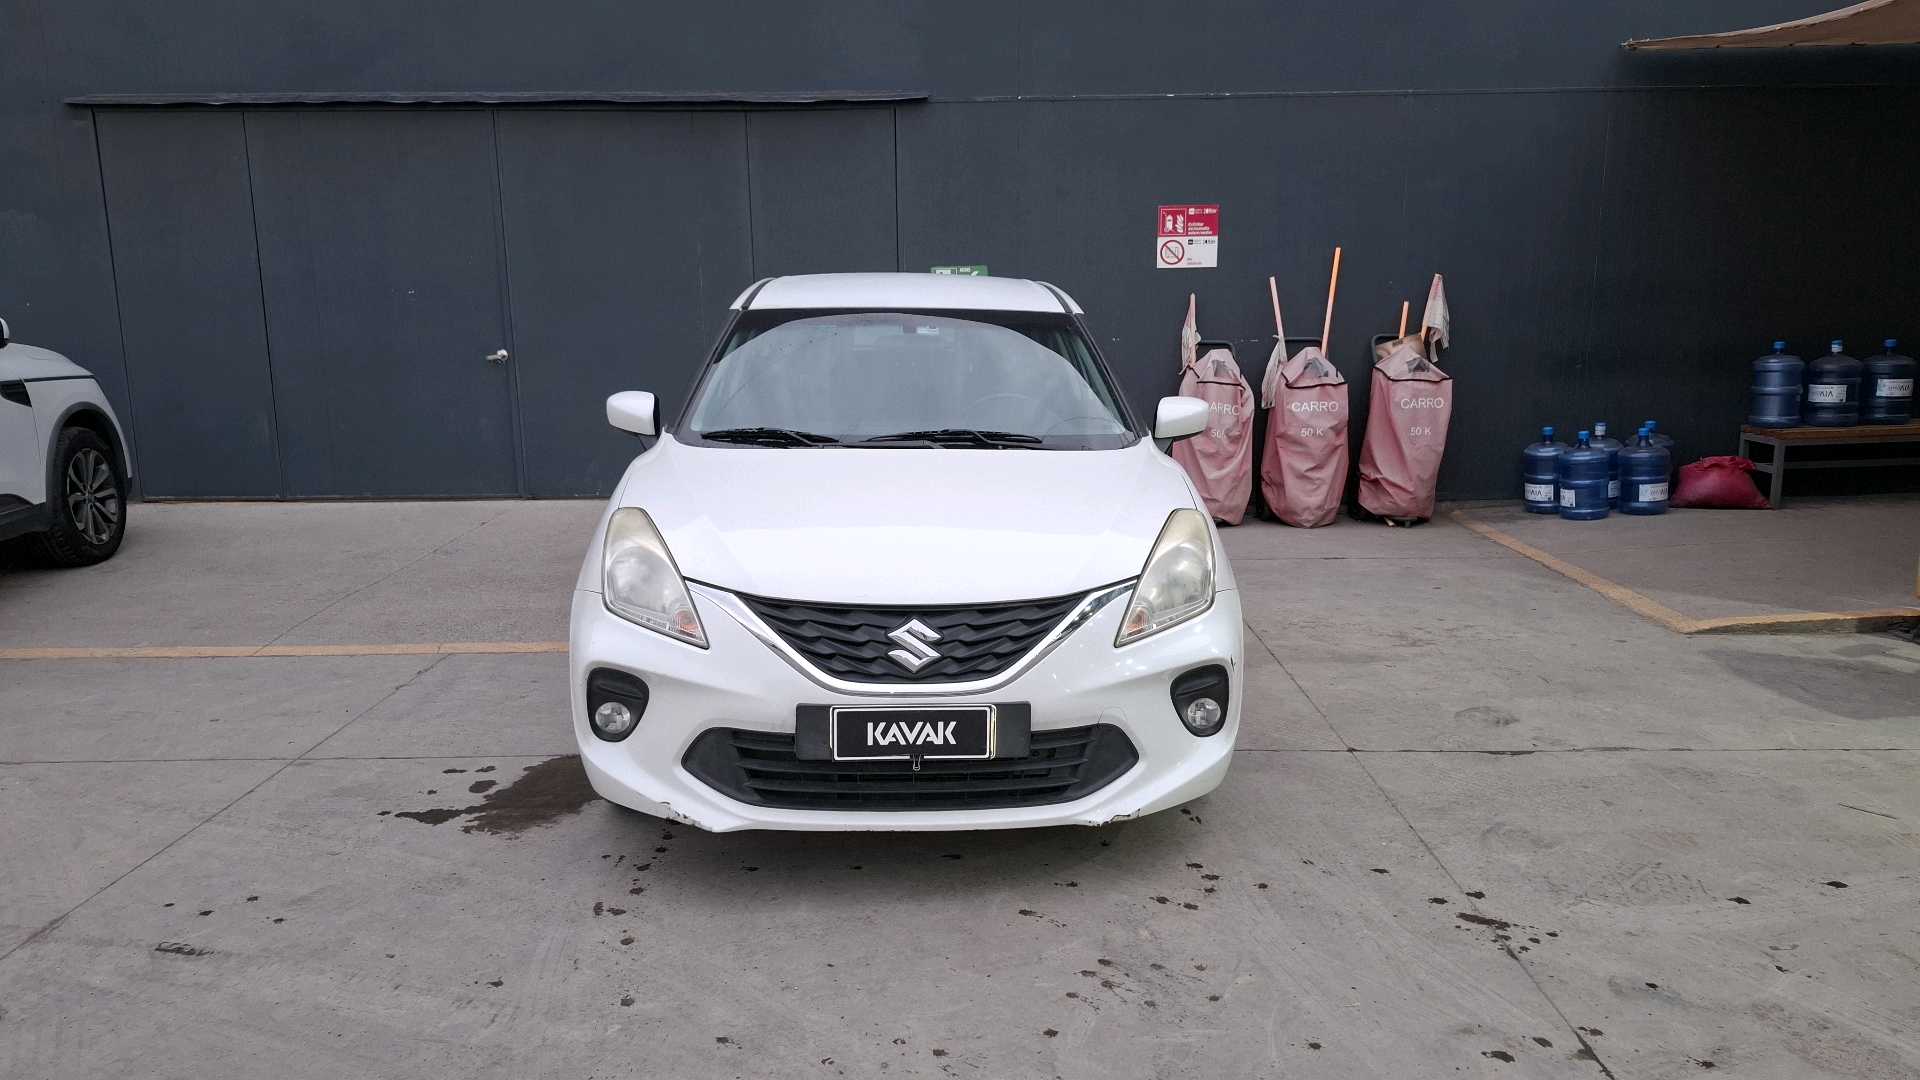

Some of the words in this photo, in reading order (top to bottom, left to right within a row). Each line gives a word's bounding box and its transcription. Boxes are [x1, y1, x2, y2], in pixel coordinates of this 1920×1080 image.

[1209, 401, 1240, 416] ARRO
[1291, 401, 1339, 412] CARRO
[1400, 397, 1445, 409] CARRO
[1300, 427, 1313, 437] 50
[1316, 427, 1324, 437] K
[1409, 426, 1422, 436] 50
[1424, 426, 1432, 436] K
[867, 721, 957, 746] KAVAK
